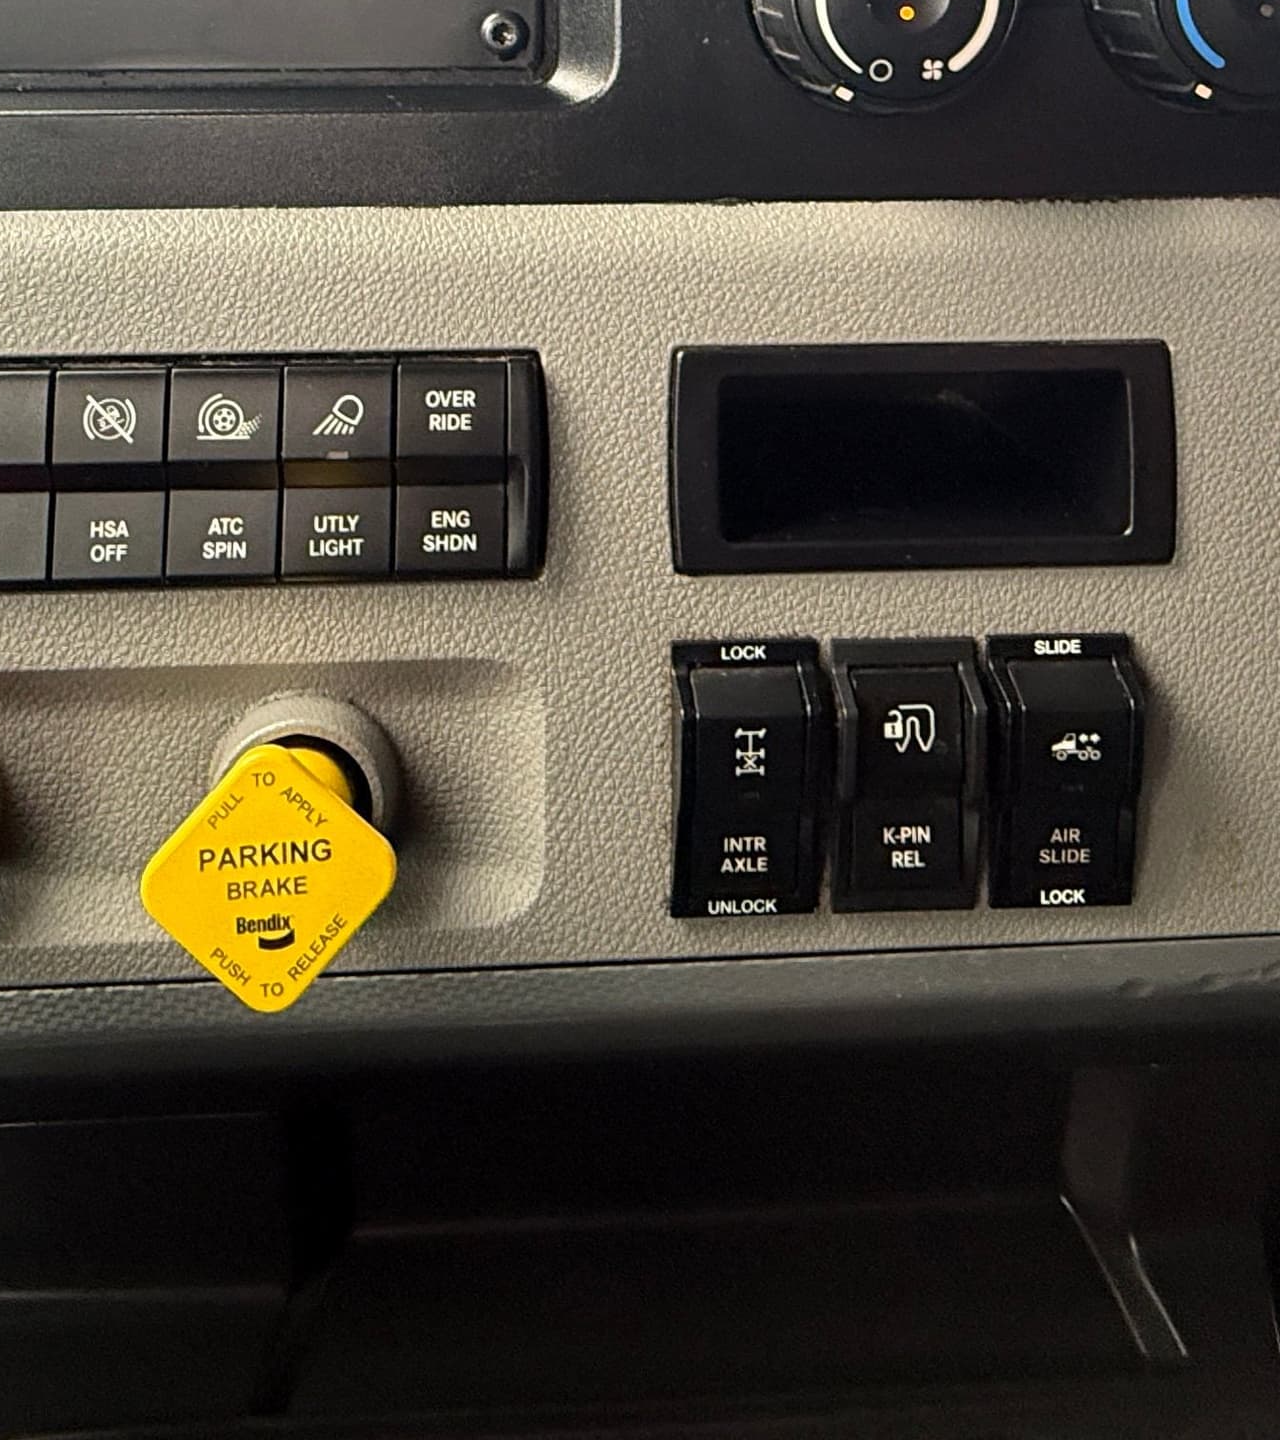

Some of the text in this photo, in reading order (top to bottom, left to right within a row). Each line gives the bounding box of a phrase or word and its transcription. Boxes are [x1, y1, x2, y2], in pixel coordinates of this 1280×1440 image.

[424, 389, 477, 410] OVER
[428, 412, 473, 432] RIDE
[89, 519, 129, 540] HSA
[207, 517, 244, 537] ATC
[313, 514, 359, 536] UTLY
[430, 510, 470, 531] ENG
[90, 542, 128, 563] OFF
[202, 540, 247, 560] SPIN
[308, 537, 364, 558] LIGHT
[422, 533, 478, 554] SHDN
[721, 644, 767, 661] LOCK
[1034, 638, 1082, 656] SLIDE
[207, 771, 328, 830] PULL TO APPLY
[723, 835, 767, 854] INTR
[883, 826, 932, 846] K-PIN
[1050, 828, 1081, 845] AIR
[199, 838, 332, 872] PARKING
[720, 856, 768, 874] AXLE
[891, 849, 925, 869] REL
[1038, 847, 1091, 866] SLIDE
[226, 875, 308, 901] BRAKE
[1039, 888, 1086, 906] LOCK
[707, 898, 777, 916] UNLOCK
[236, 912, 292, 935] Bendix
[209, 912, 348, 998] PUSH TO RELEASE
